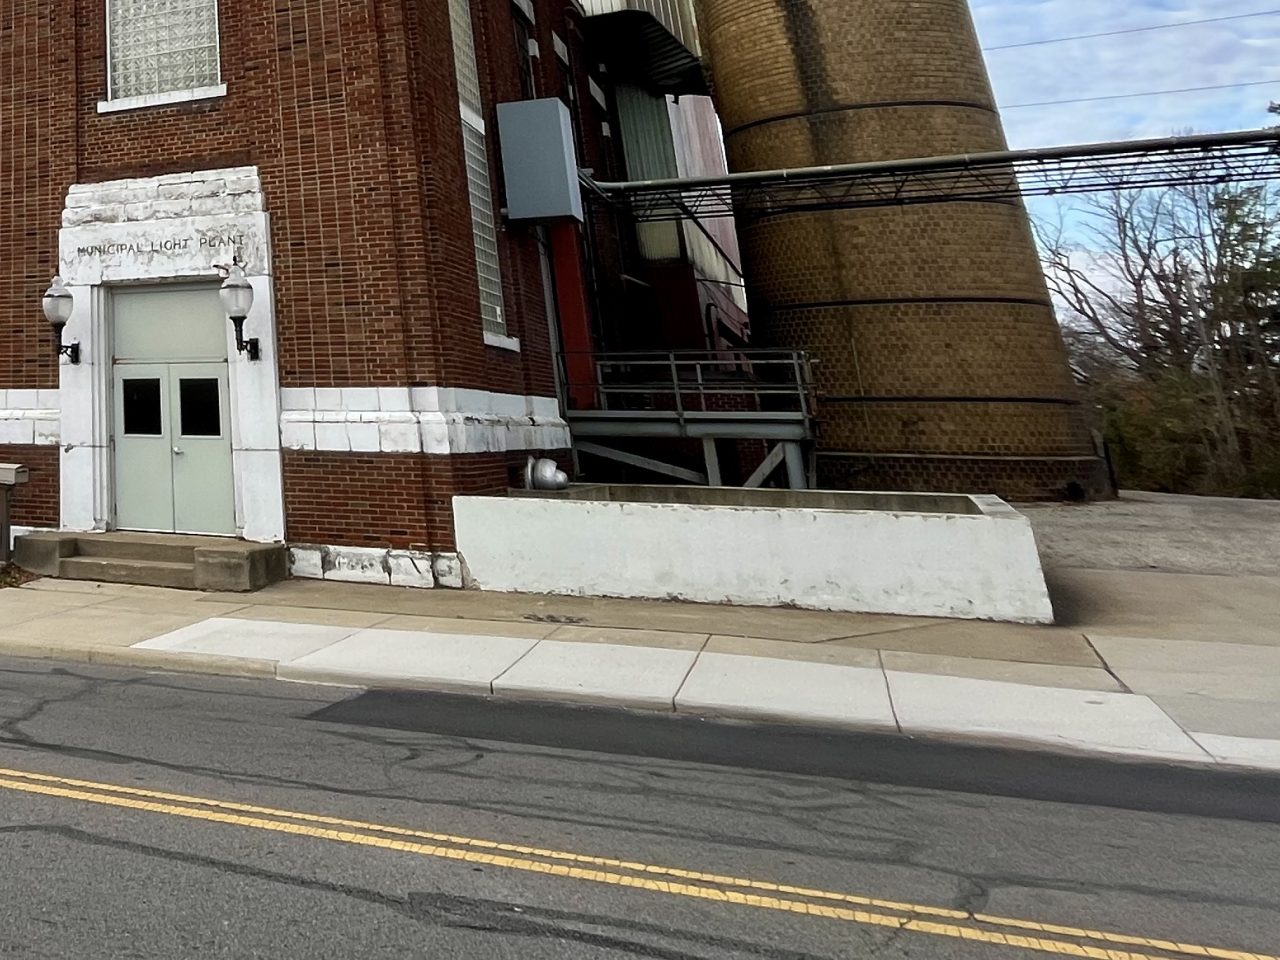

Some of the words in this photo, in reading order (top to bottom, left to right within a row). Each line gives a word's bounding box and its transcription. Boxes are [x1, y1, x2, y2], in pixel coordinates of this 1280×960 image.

[77, 243, 142, 257] MUNICIPAL
[151, 239, 189, 253] LIGHT
[199, 234, 245, 249] PLANT
